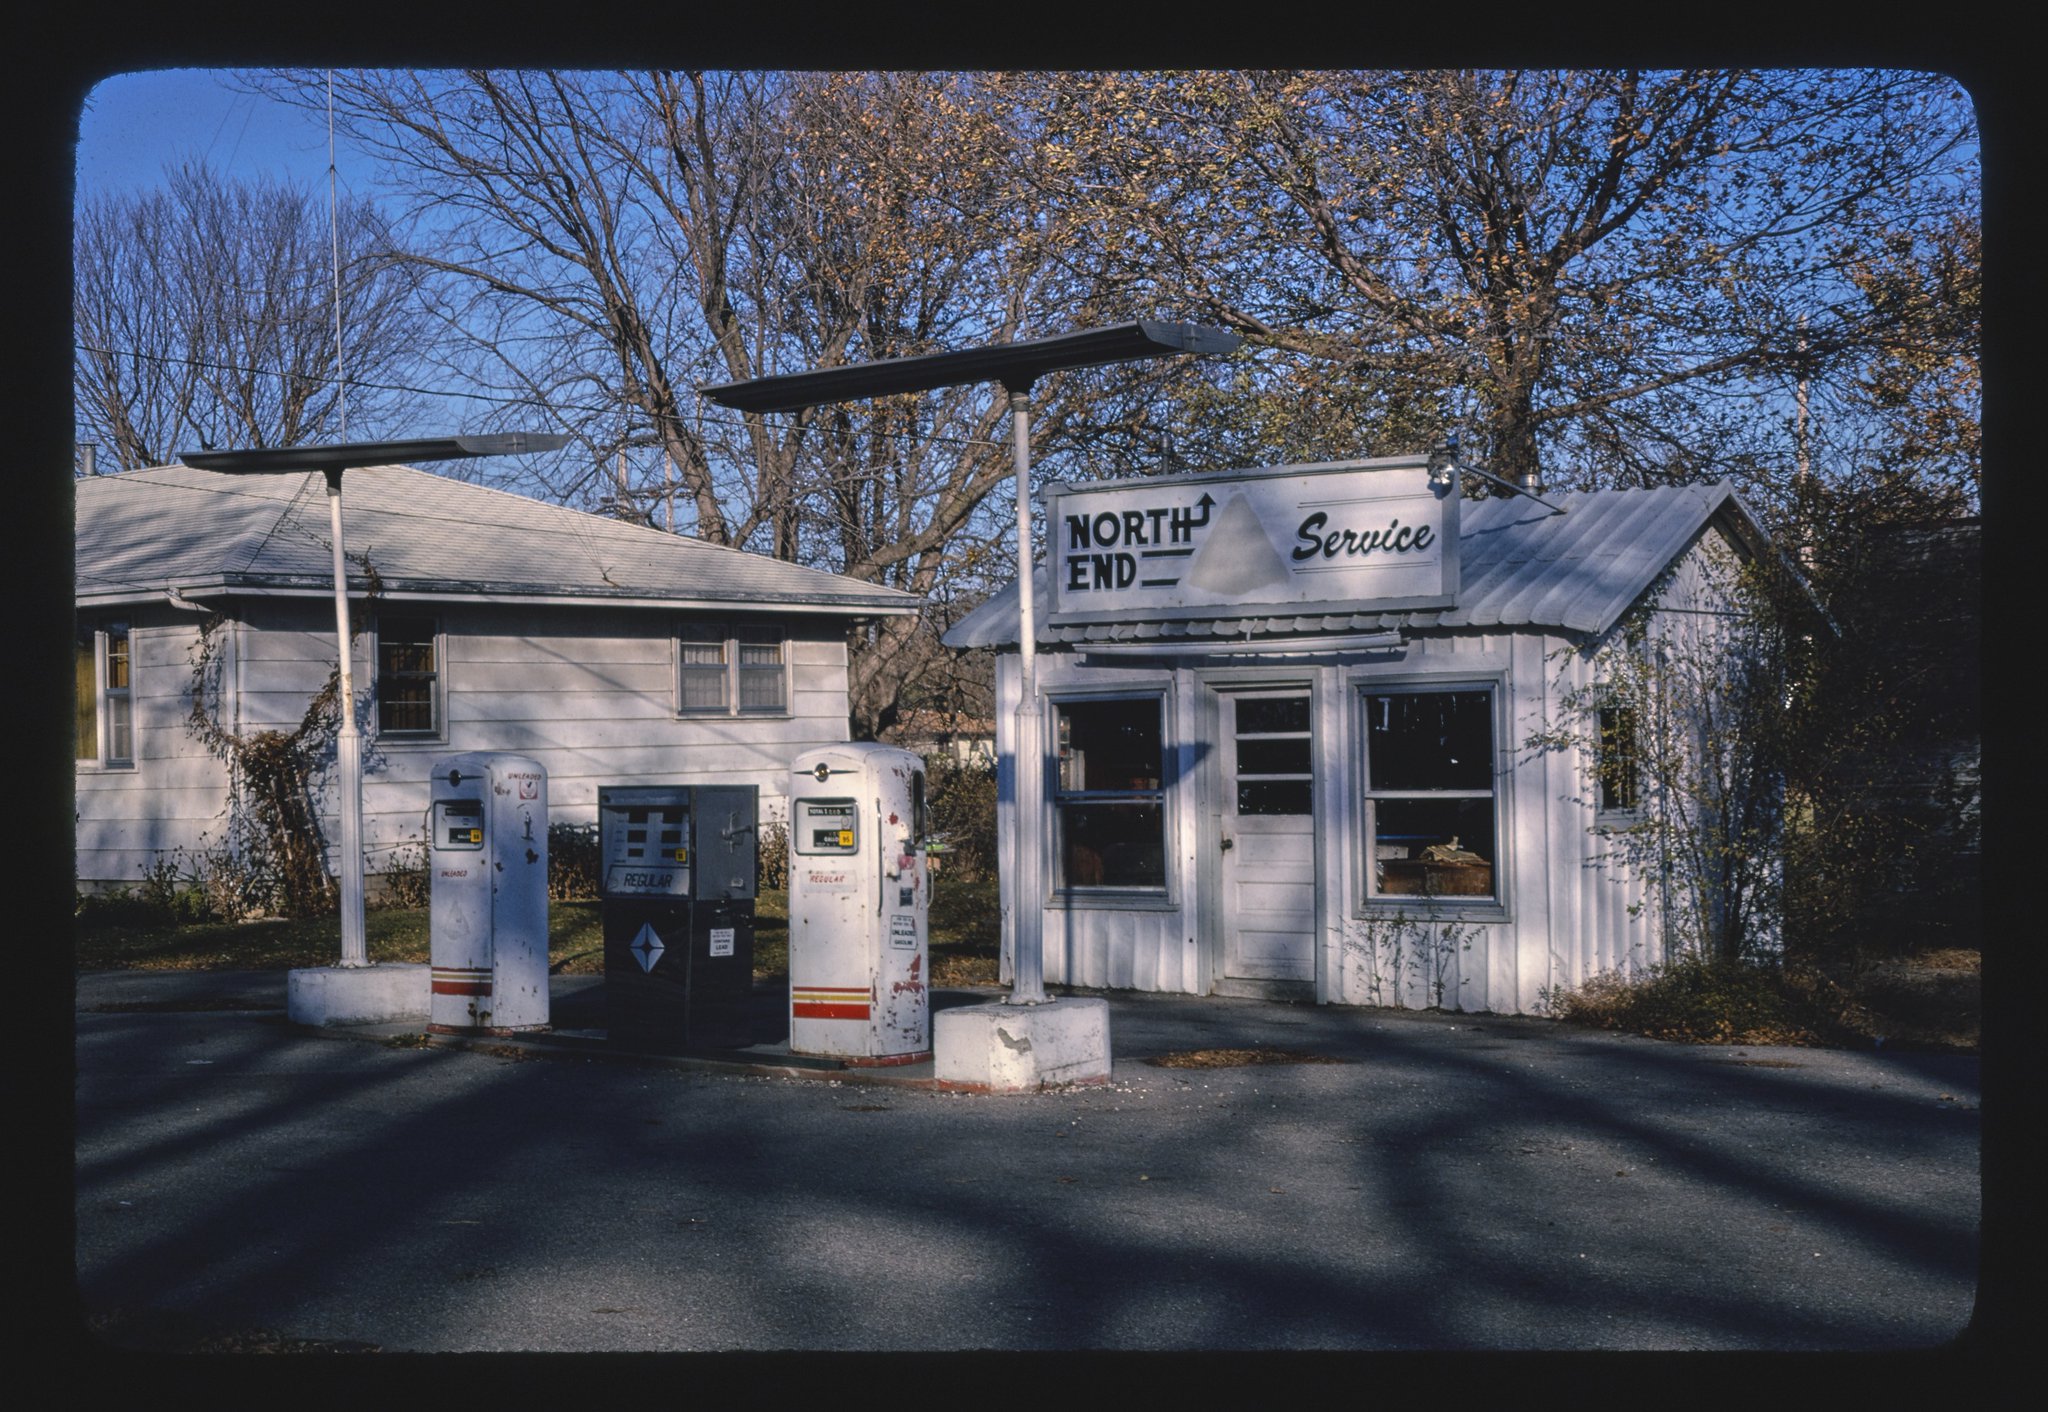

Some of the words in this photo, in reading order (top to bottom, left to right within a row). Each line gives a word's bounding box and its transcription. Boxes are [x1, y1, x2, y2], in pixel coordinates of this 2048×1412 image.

[1066, 506, 1191, 549] NORTH
[1291, 511, 1436, 561] Service
[1067, 552, 1137, 591] END
[508, 772, 542, 780] UNLEADED
[441, 869, 468, 878] UNLEADED
[624, 872, 674, 888] REGULAR
[810, 875, 845, 883] REGULAR
